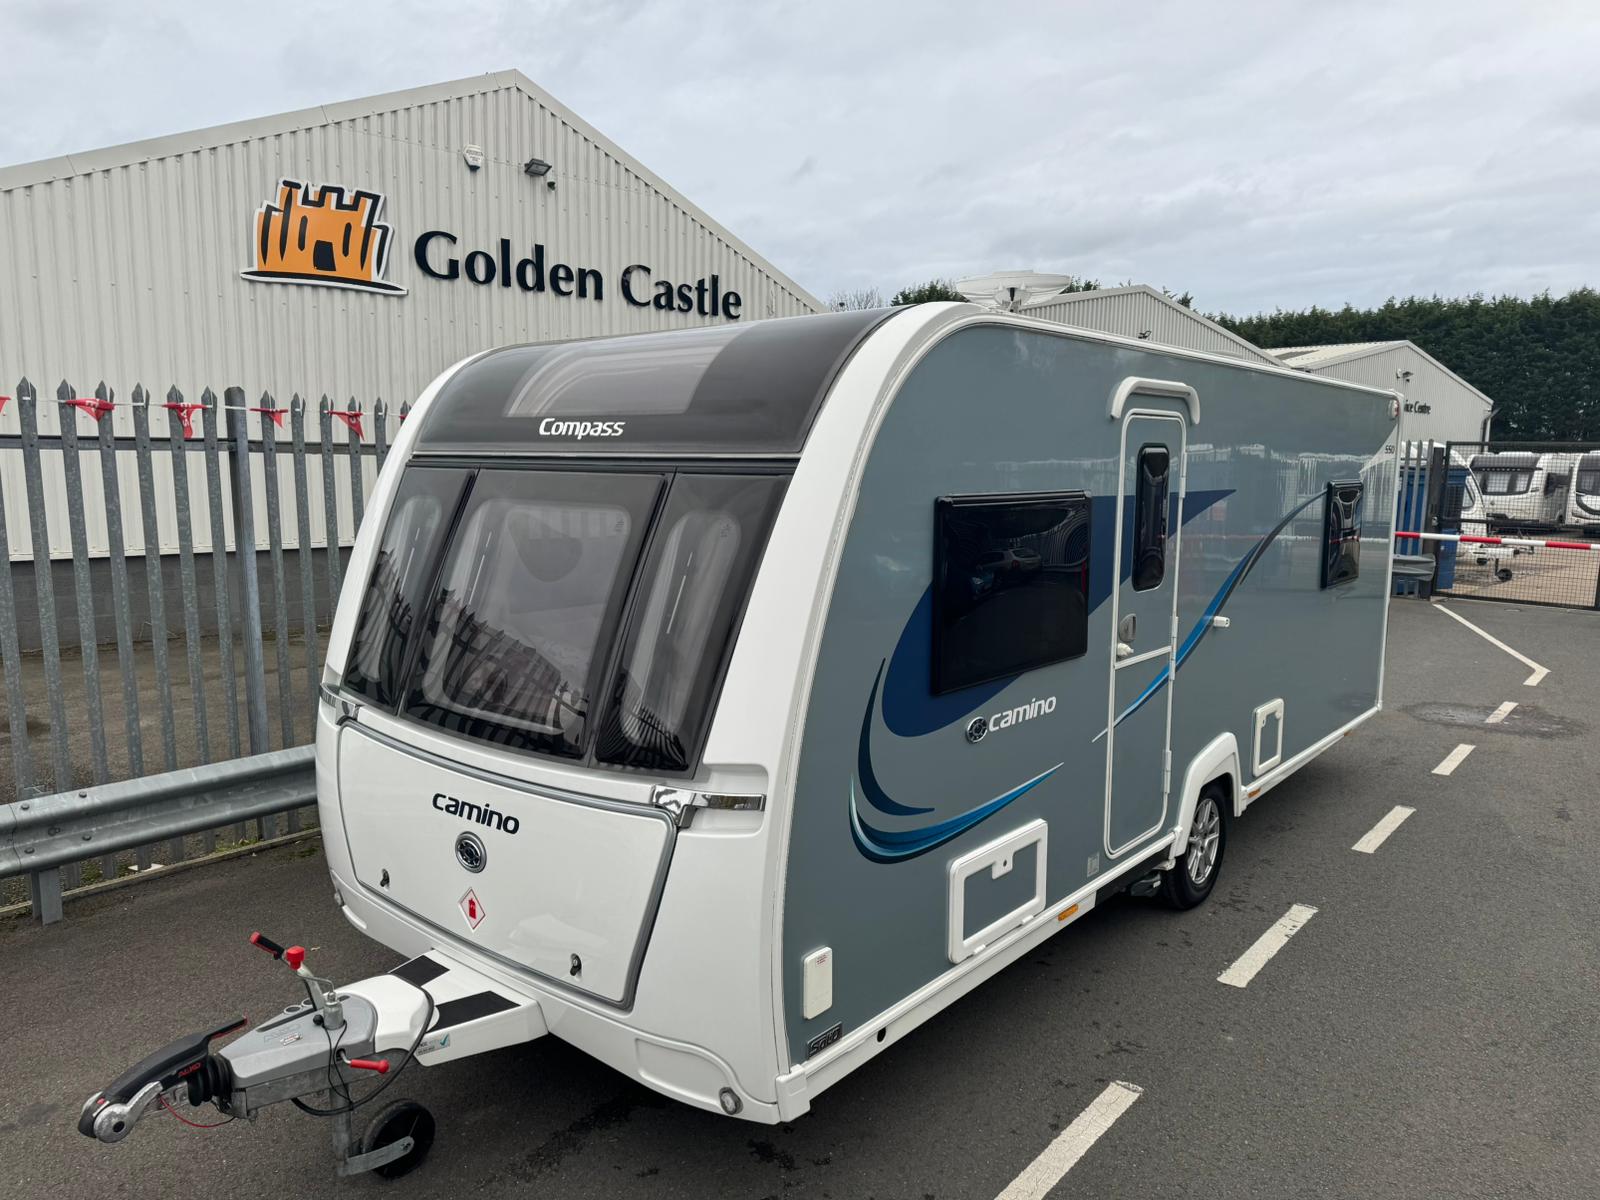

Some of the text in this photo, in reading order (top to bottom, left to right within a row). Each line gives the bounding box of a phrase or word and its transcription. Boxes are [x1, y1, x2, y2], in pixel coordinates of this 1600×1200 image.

[414, 230, 742, 320] Golden Castle
[539, 417, 626, 441] Compass
[988, 696, 1057, 732] camino
[432, 793, 520, 835] camino
